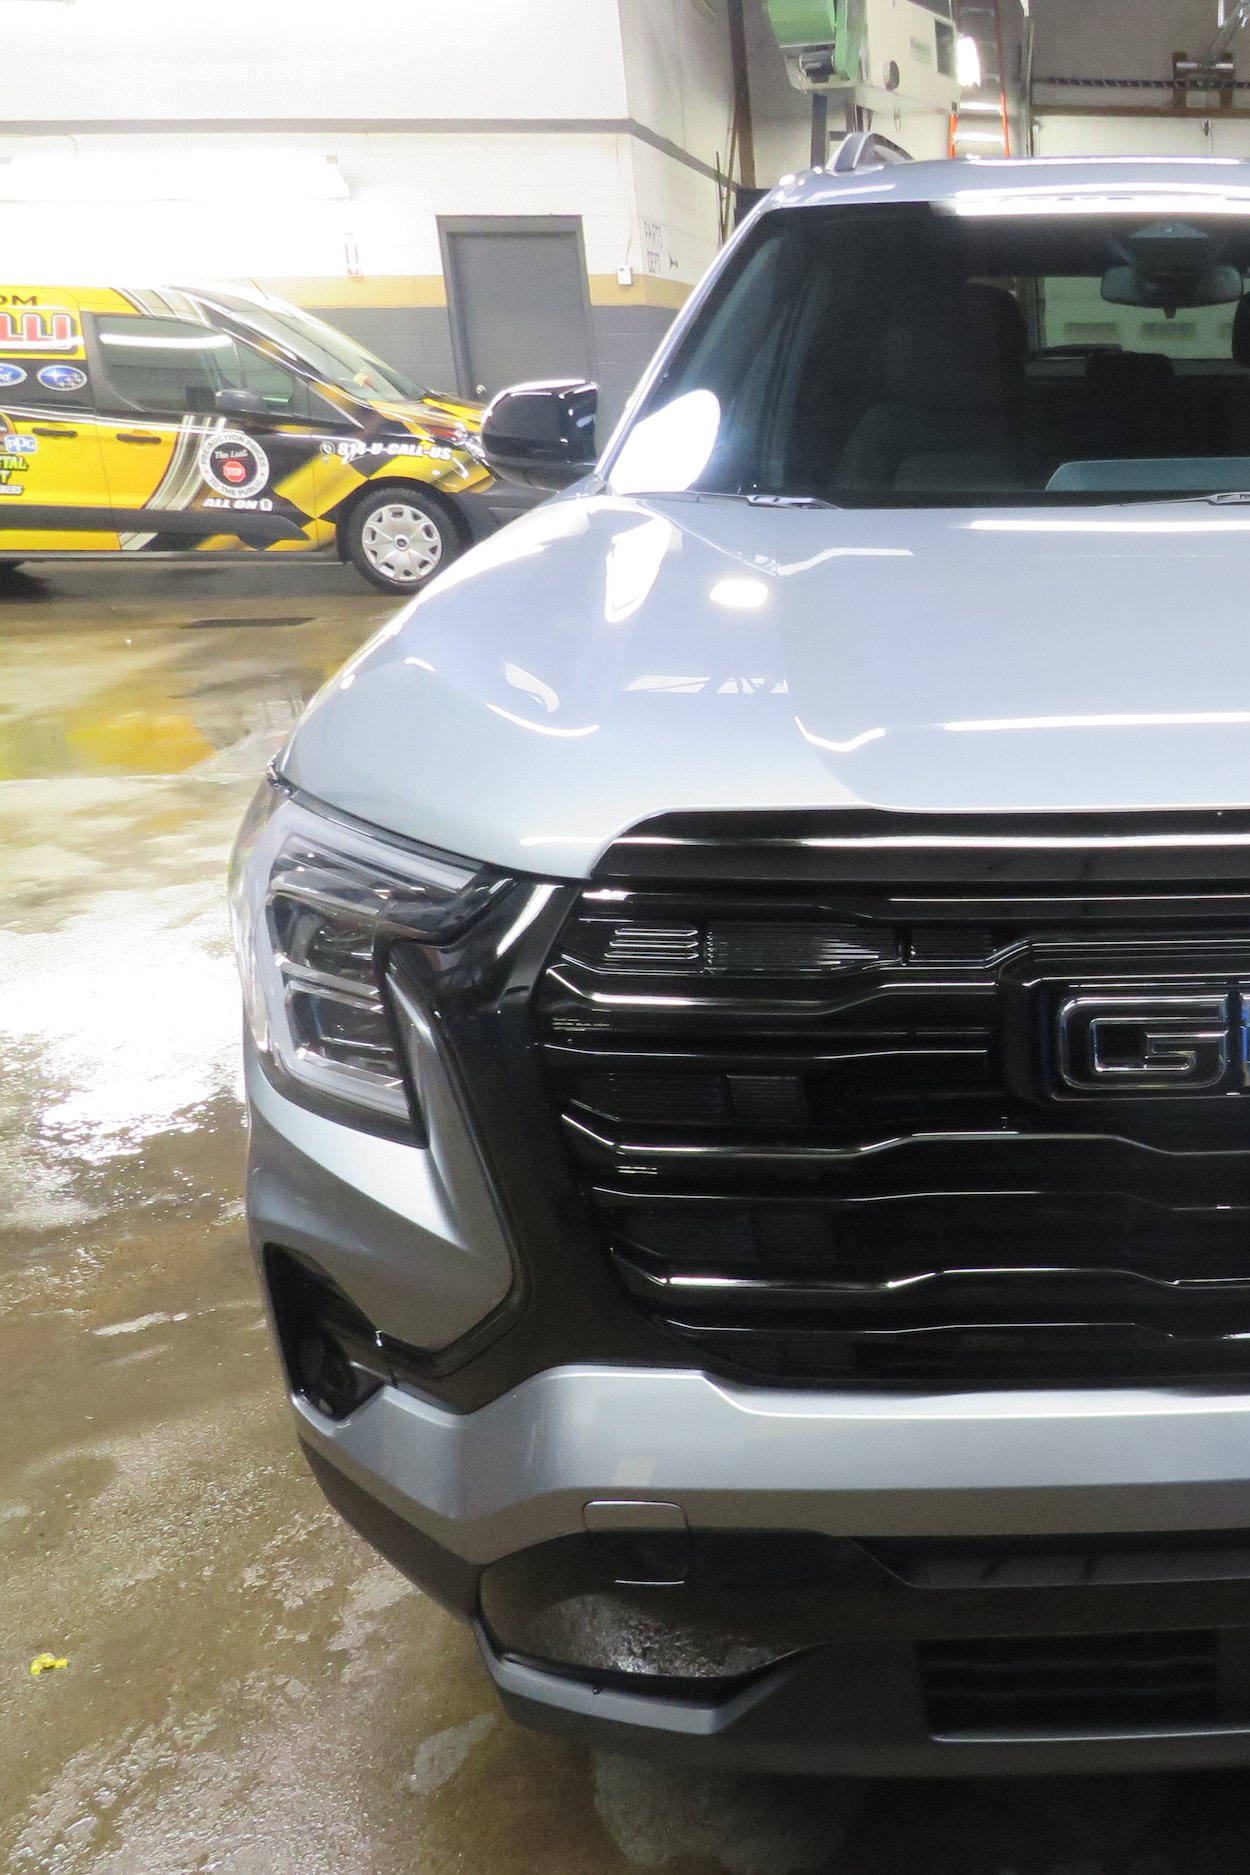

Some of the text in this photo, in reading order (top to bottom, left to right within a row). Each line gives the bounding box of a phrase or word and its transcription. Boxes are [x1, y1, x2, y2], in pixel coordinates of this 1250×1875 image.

[8, 437, 35, 452] PPG
[337, 442, 452, 460] 814-U-CALL-US
[214, 448, 249, 459] The Last
[245, 439, 267, 467] PRICES
[209, 478, 263, 497] TO THE PUBLIC
[202, 498, 231, 509] ALL
[233, 499, 258, 510] ON
